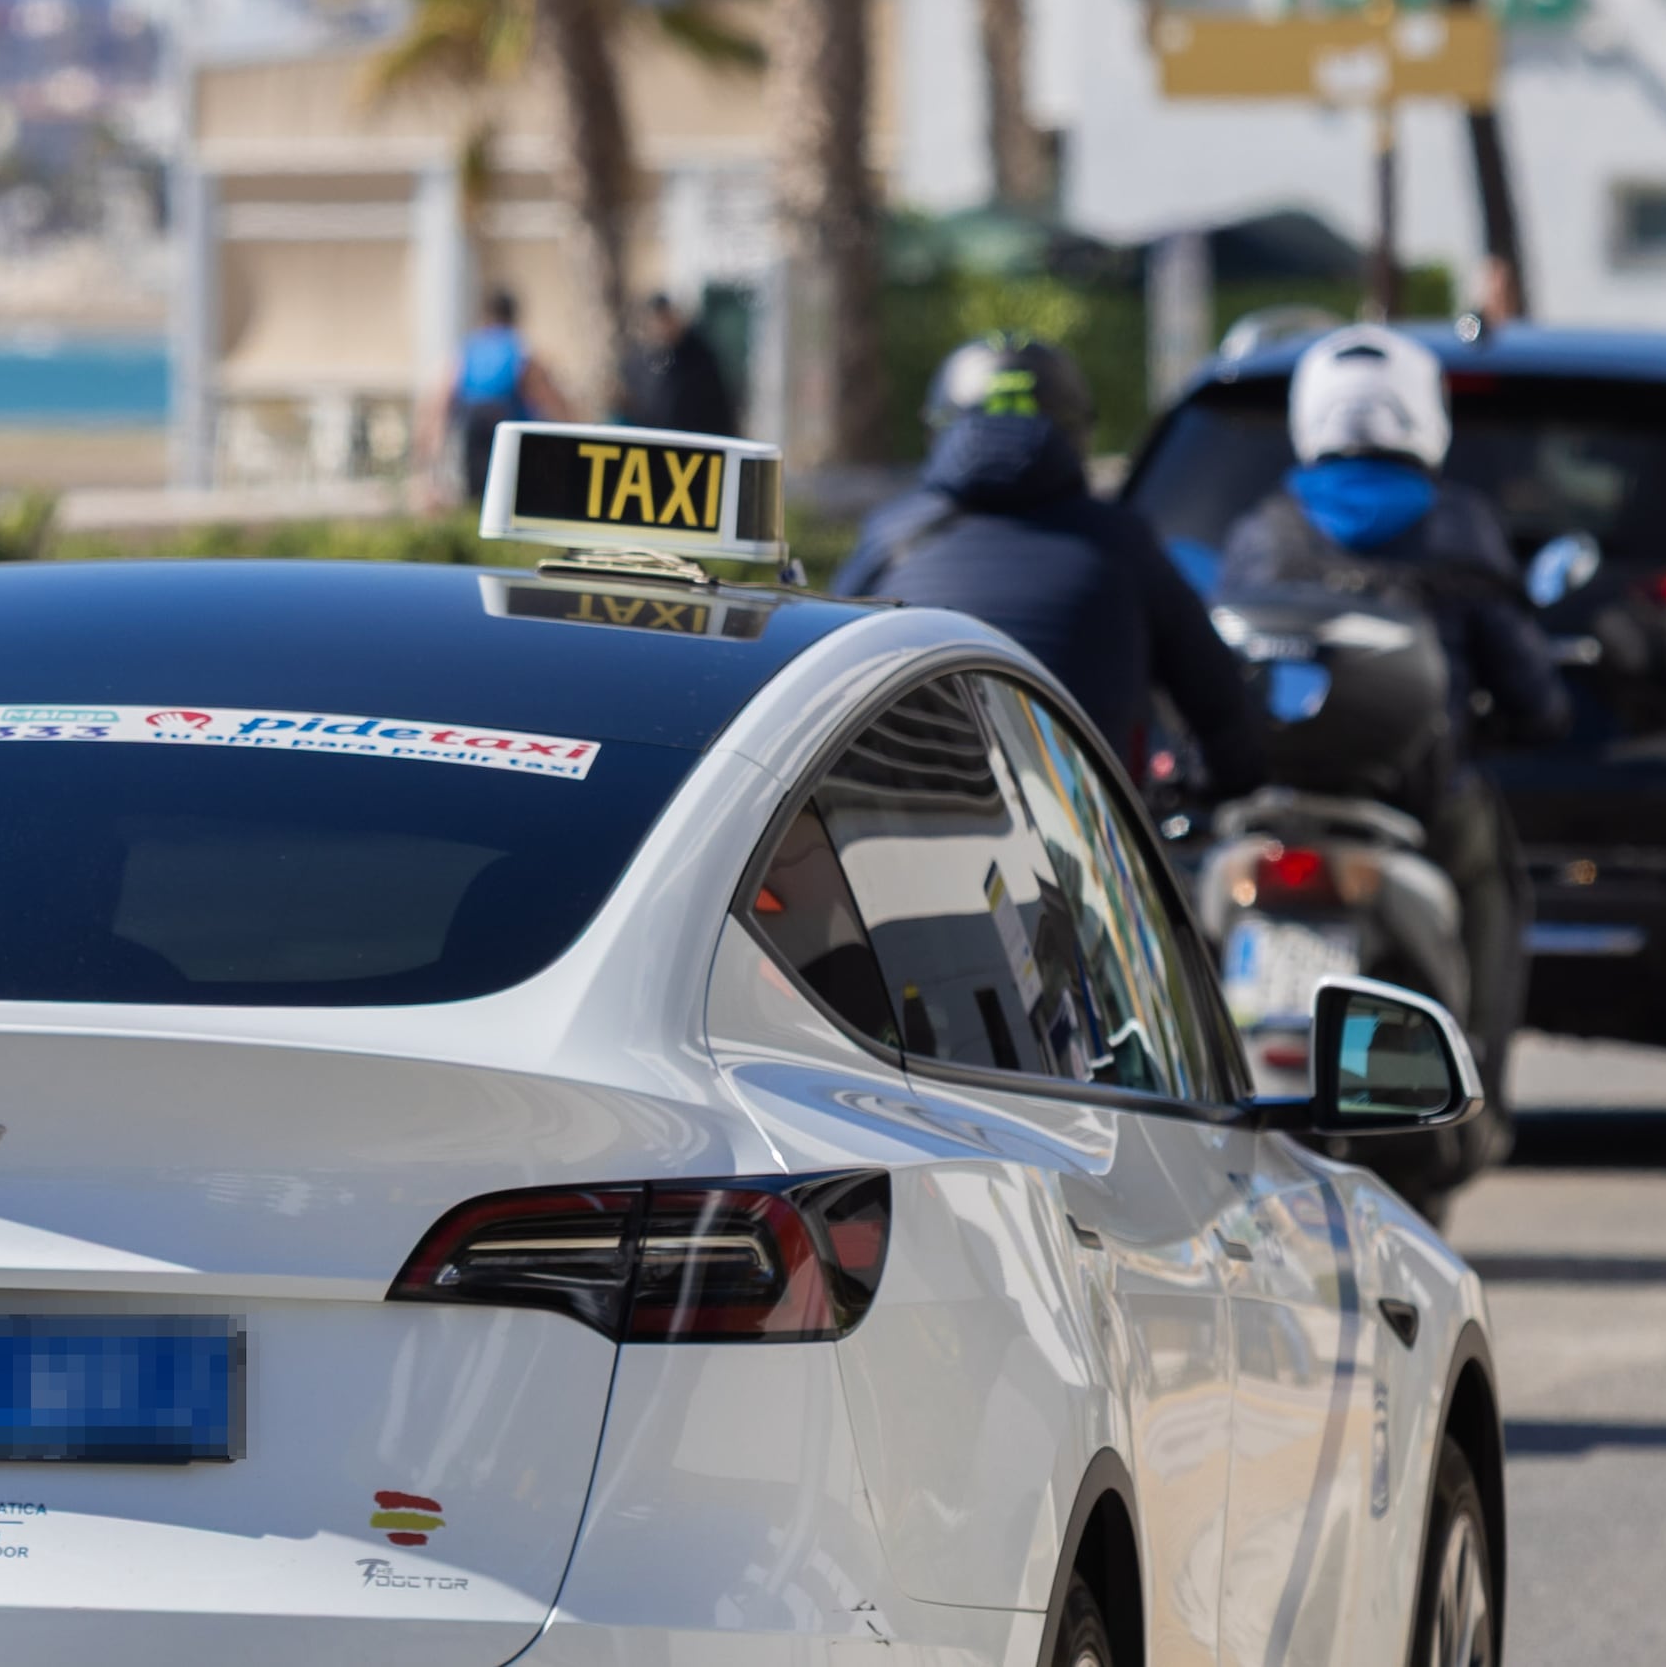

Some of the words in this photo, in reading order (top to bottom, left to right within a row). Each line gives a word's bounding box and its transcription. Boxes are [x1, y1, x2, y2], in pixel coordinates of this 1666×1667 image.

[578, 443, 722, 528] TAXI
[153, 731, 191, 739] tu
[206, 733, 278, 746] app
[291, 739, 377, 753] para
[392, 746, 496, 764] pedir
[509, 758, 580, 776] taxi
[238, 717, 590, 761] pidetaxi
[375, 1575, 469, 1590] DOCTOR
